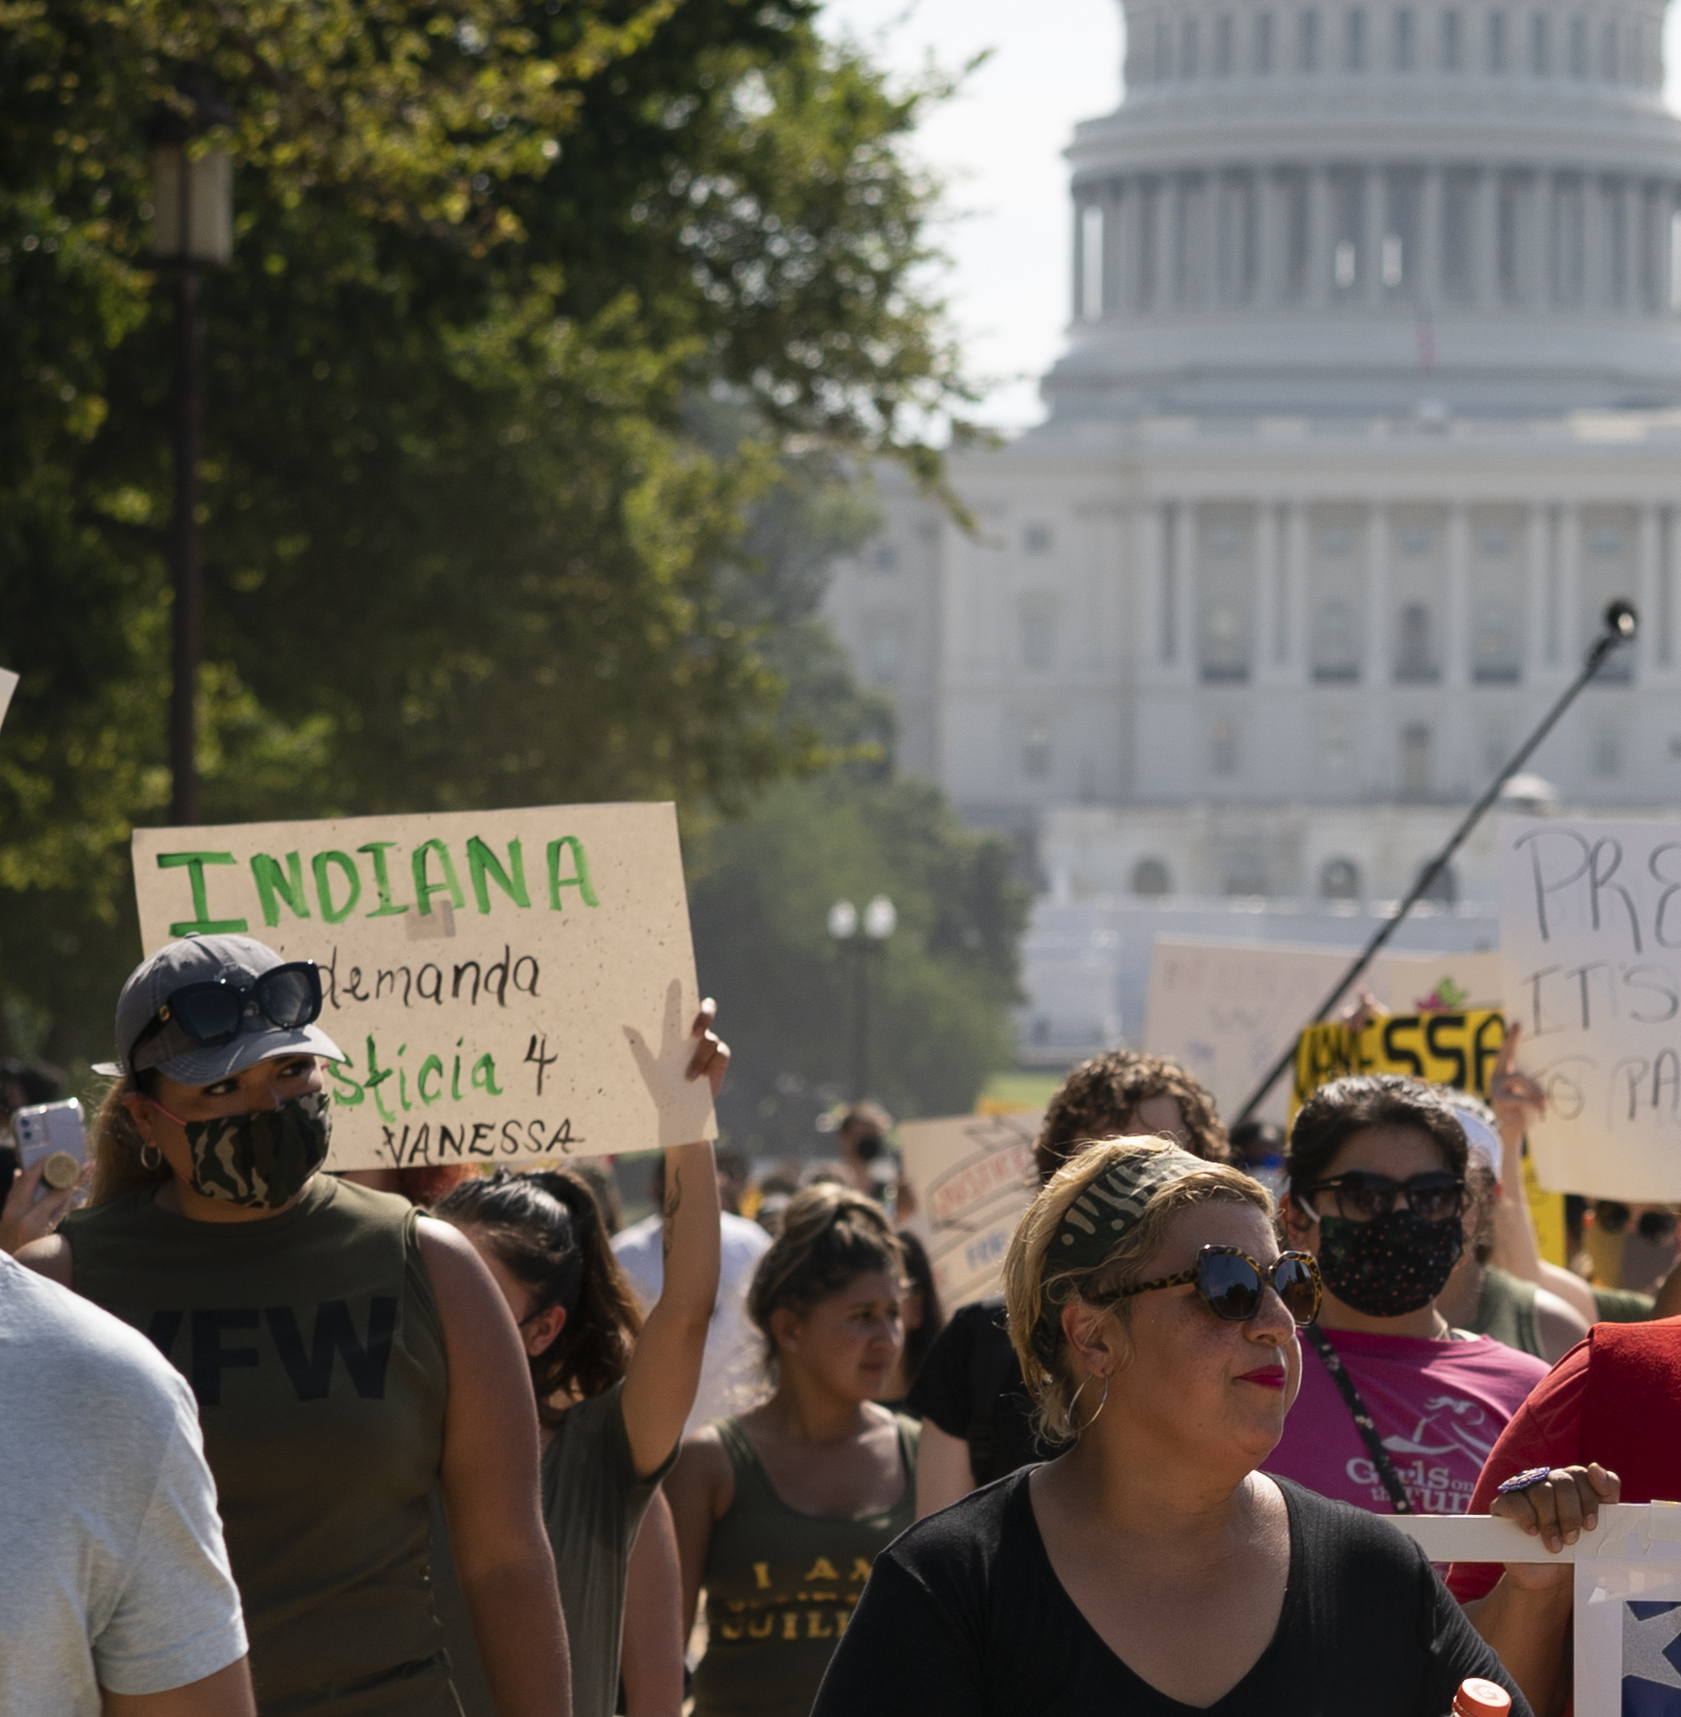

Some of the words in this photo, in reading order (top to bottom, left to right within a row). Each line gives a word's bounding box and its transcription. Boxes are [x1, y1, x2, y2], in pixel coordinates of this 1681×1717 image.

[156, 835, 600, 937] INDIANA
[317, 944, 542, 1009] demanda
[327, 1033, 503, 1124] sticia
[523, 1033, 559, 1097] 4
[381, 1117, 586, 1168] VANESSA
[1345, 1457, 1450, 1490] Grls
